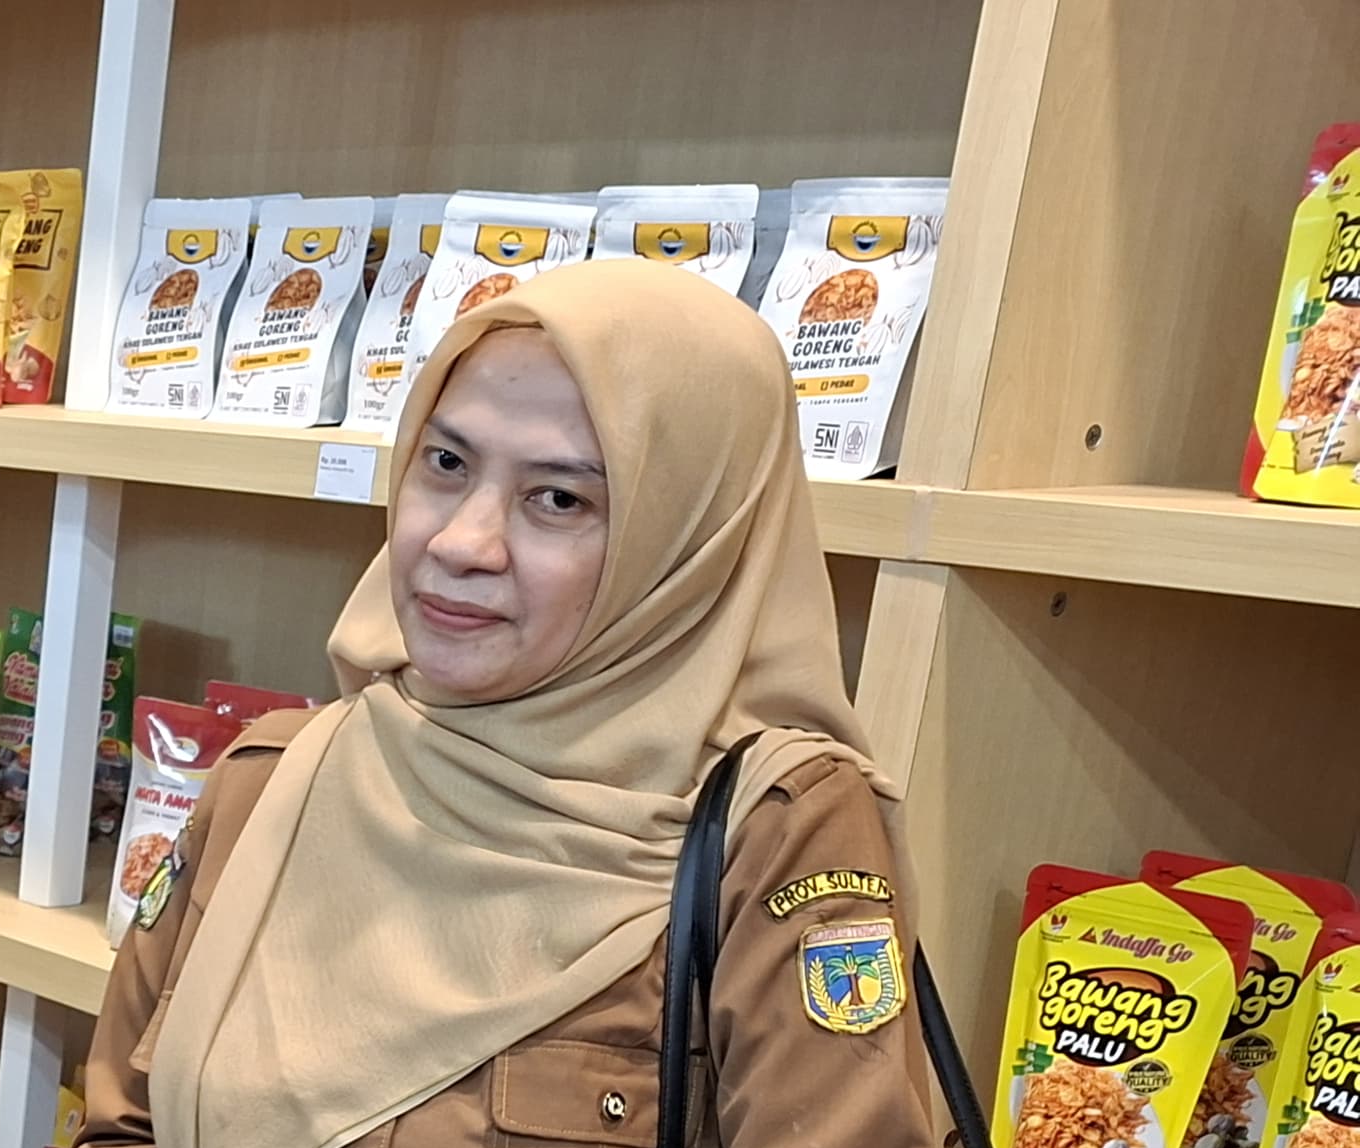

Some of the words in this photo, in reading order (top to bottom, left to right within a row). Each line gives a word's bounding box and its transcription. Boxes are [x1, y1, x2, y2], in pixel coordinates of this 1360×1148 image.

[1328, 276, 1360, 298] PA
[148, 308, 188, 321] BAWANG
[262, 309, 306, 323] BAWANG
[145, 320, 185, 335] GORENG
[259, 321, 301, 336] GORENG
[797, 320, 862, 340] BAWANG
[792, 338, 854, 357] GORENG
[839, 355, 881, 368] TENGAH
[168, 387, 183, 402] SNI
[274, 391, 290, 406] SNI
[814, 428, 839, 448] SNI
[772, 880, 824, 912] PROV.
[828, 871, 889, 896] SULTEN
[1166, 942, 1195, 963] Go
[1040, 963, 1193, 1029] Bawang
[1042, 996, 1166, 1050] goreng
[1056, 1030, 1125, 1063] PALU
[1314, 1086, 1360, 1119] PAL
